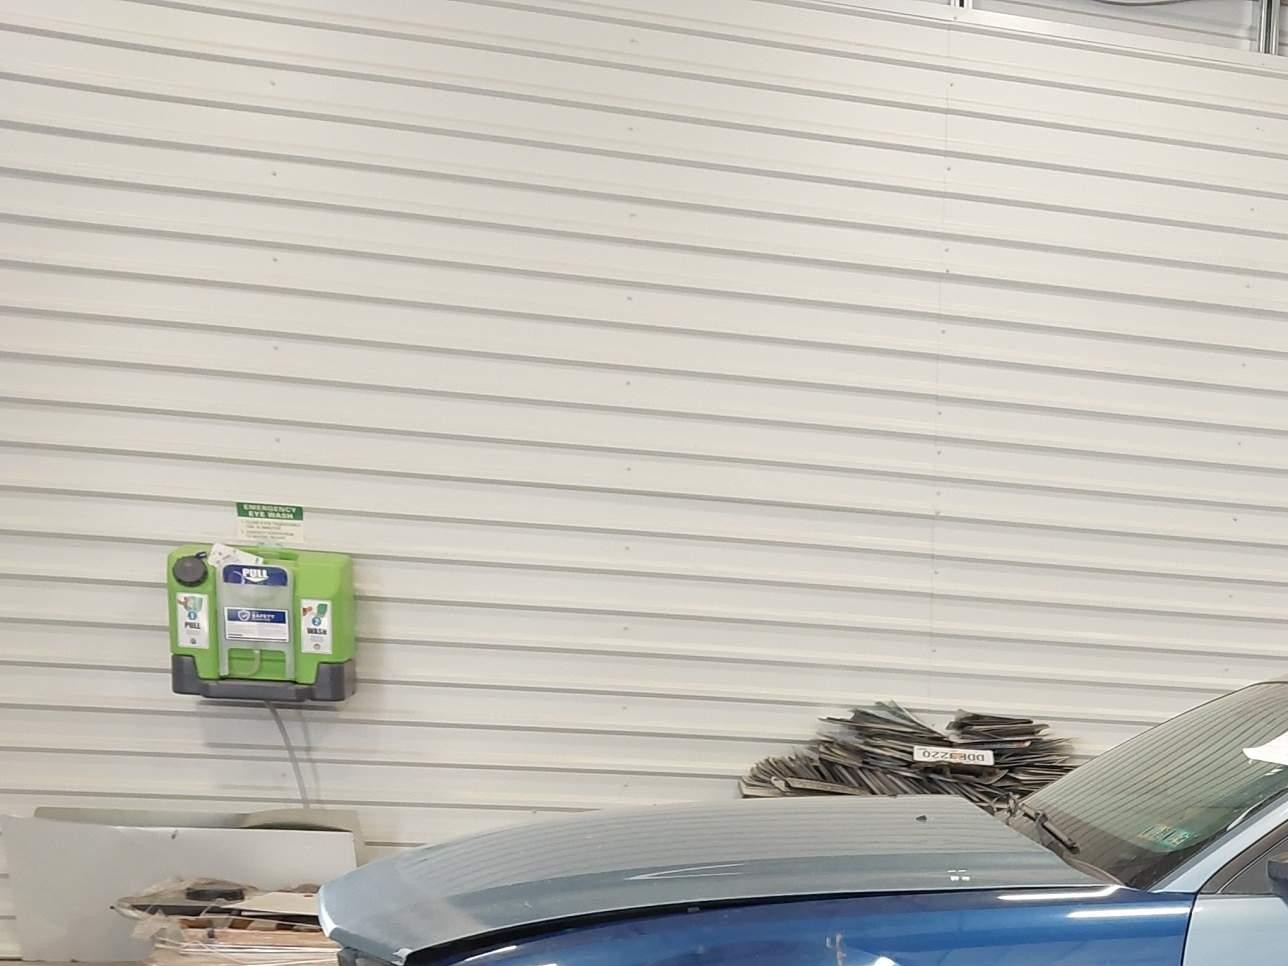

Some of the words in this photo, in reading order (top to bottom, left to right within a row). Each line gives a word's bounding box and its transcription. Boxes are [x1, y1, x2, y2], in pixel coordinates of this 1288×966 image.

[243, 503, 297, 514] EMERGENCY
[248, 510, 266, 518] EYE
[267, 511, 294, 520] WASH
[241, 567, 268, 578] PULL
[184, 621, 201, 630] PULL
[306, 627, 328, 636] WASH
